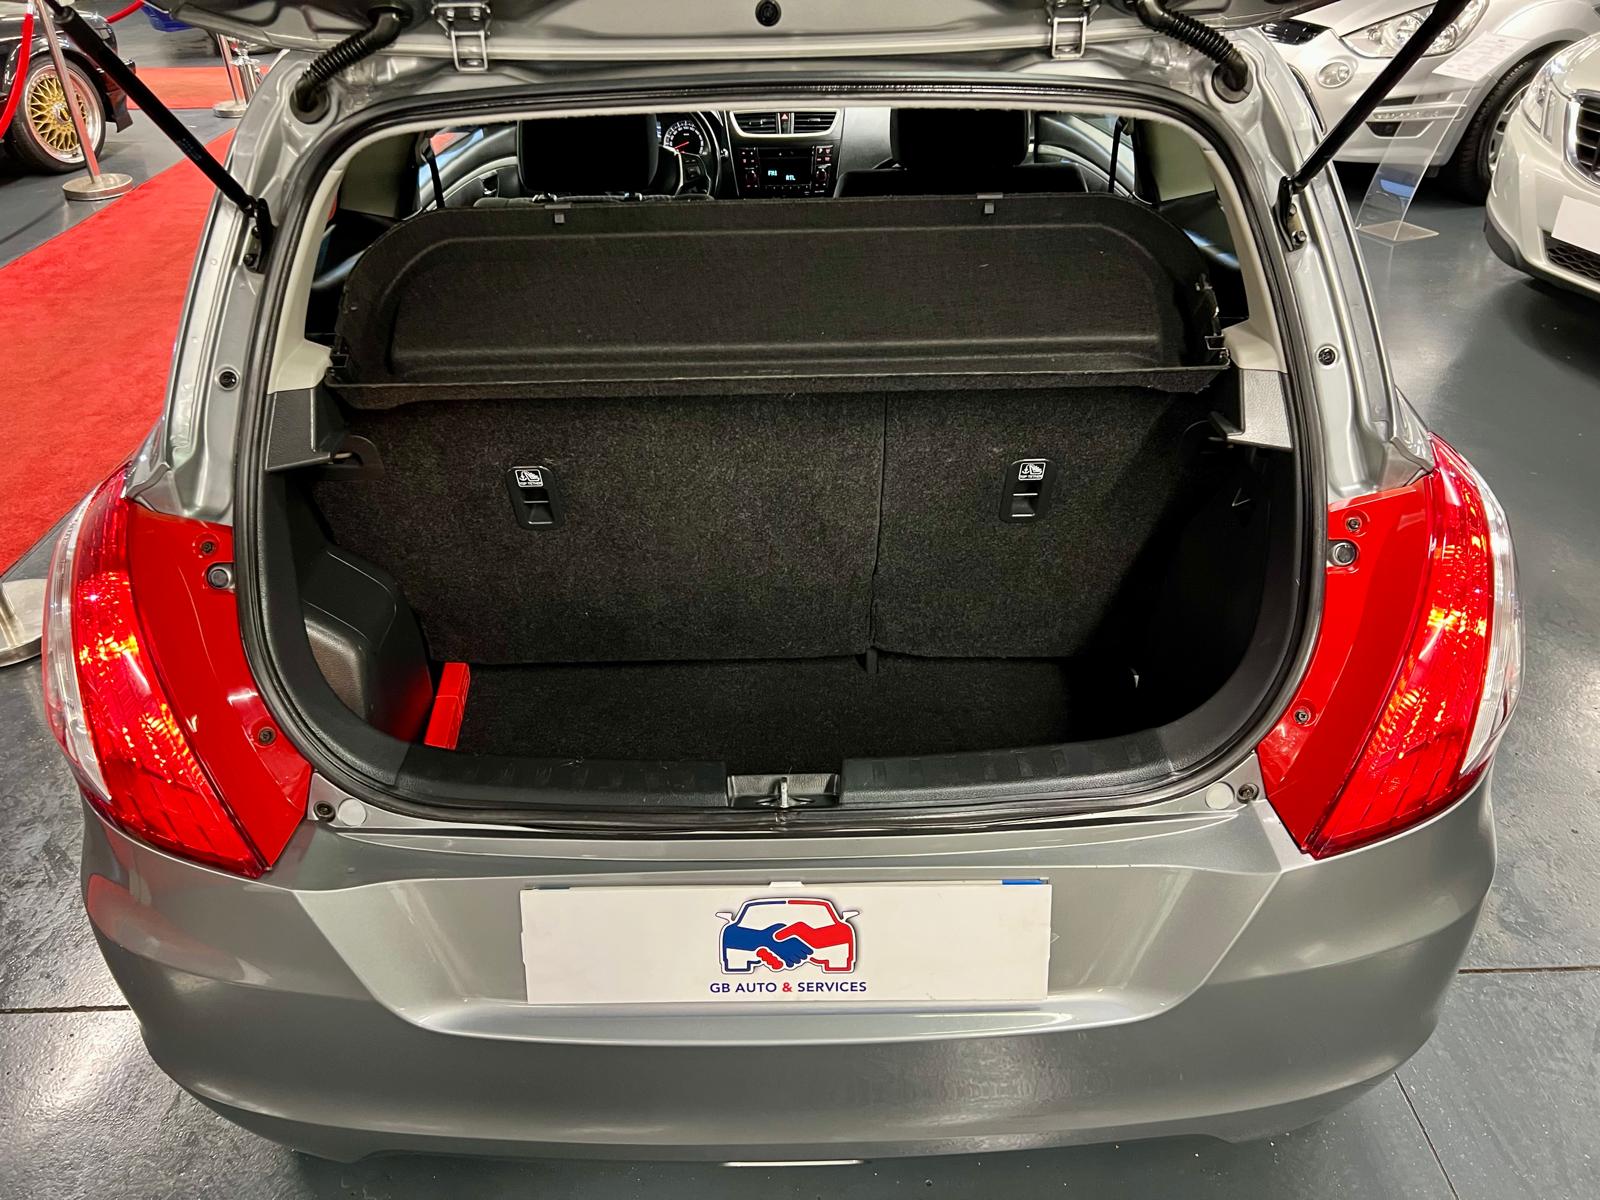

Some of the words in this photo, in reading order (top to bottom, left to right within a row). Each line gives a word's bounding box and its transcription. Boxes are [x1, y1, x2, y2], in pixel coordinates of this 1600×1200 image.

[709, 982, 731, 993] GB
[735, 982, 777, 993] AUTO
[781, 981, 793, 993] &
[797, 981, 867, 993] SERVICES
